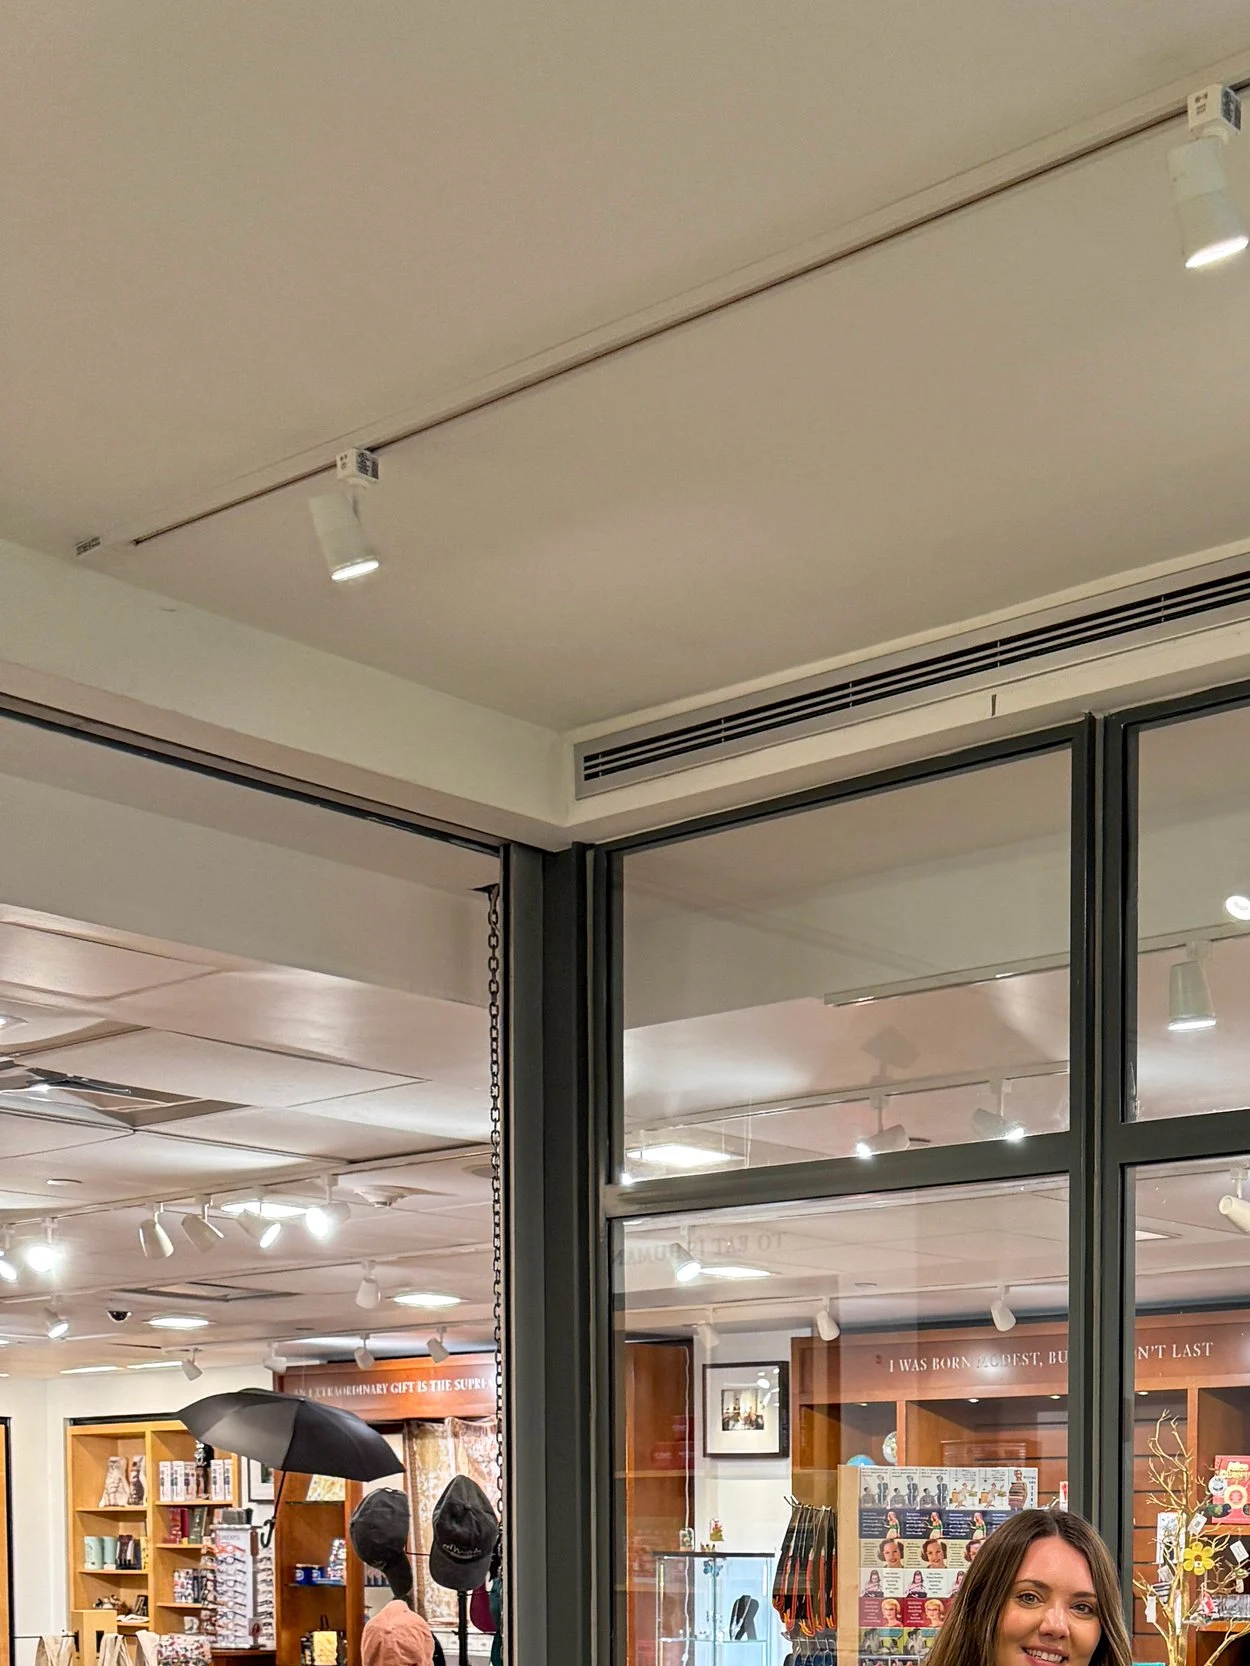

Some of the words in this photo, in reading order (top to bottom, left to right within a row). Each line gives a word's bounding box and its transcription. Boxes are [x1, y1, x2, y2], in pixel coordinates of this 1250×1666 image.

[888, 1359, 895, 1373] I
[898, 1358, 928, 1373] WAS
[932, 1355, 972, 1371] BORN
[1048, 1350, 1068, 1365] BU
[1171, 1341, 1215, 1359] LAST
[309, 1383, 388, 1399] EXTRAORDINARY
[390, 1380, 415, 1394] GIFT
[417, 1379, 428, 1393] IS
[430, 1378, 451, 1392] THE
